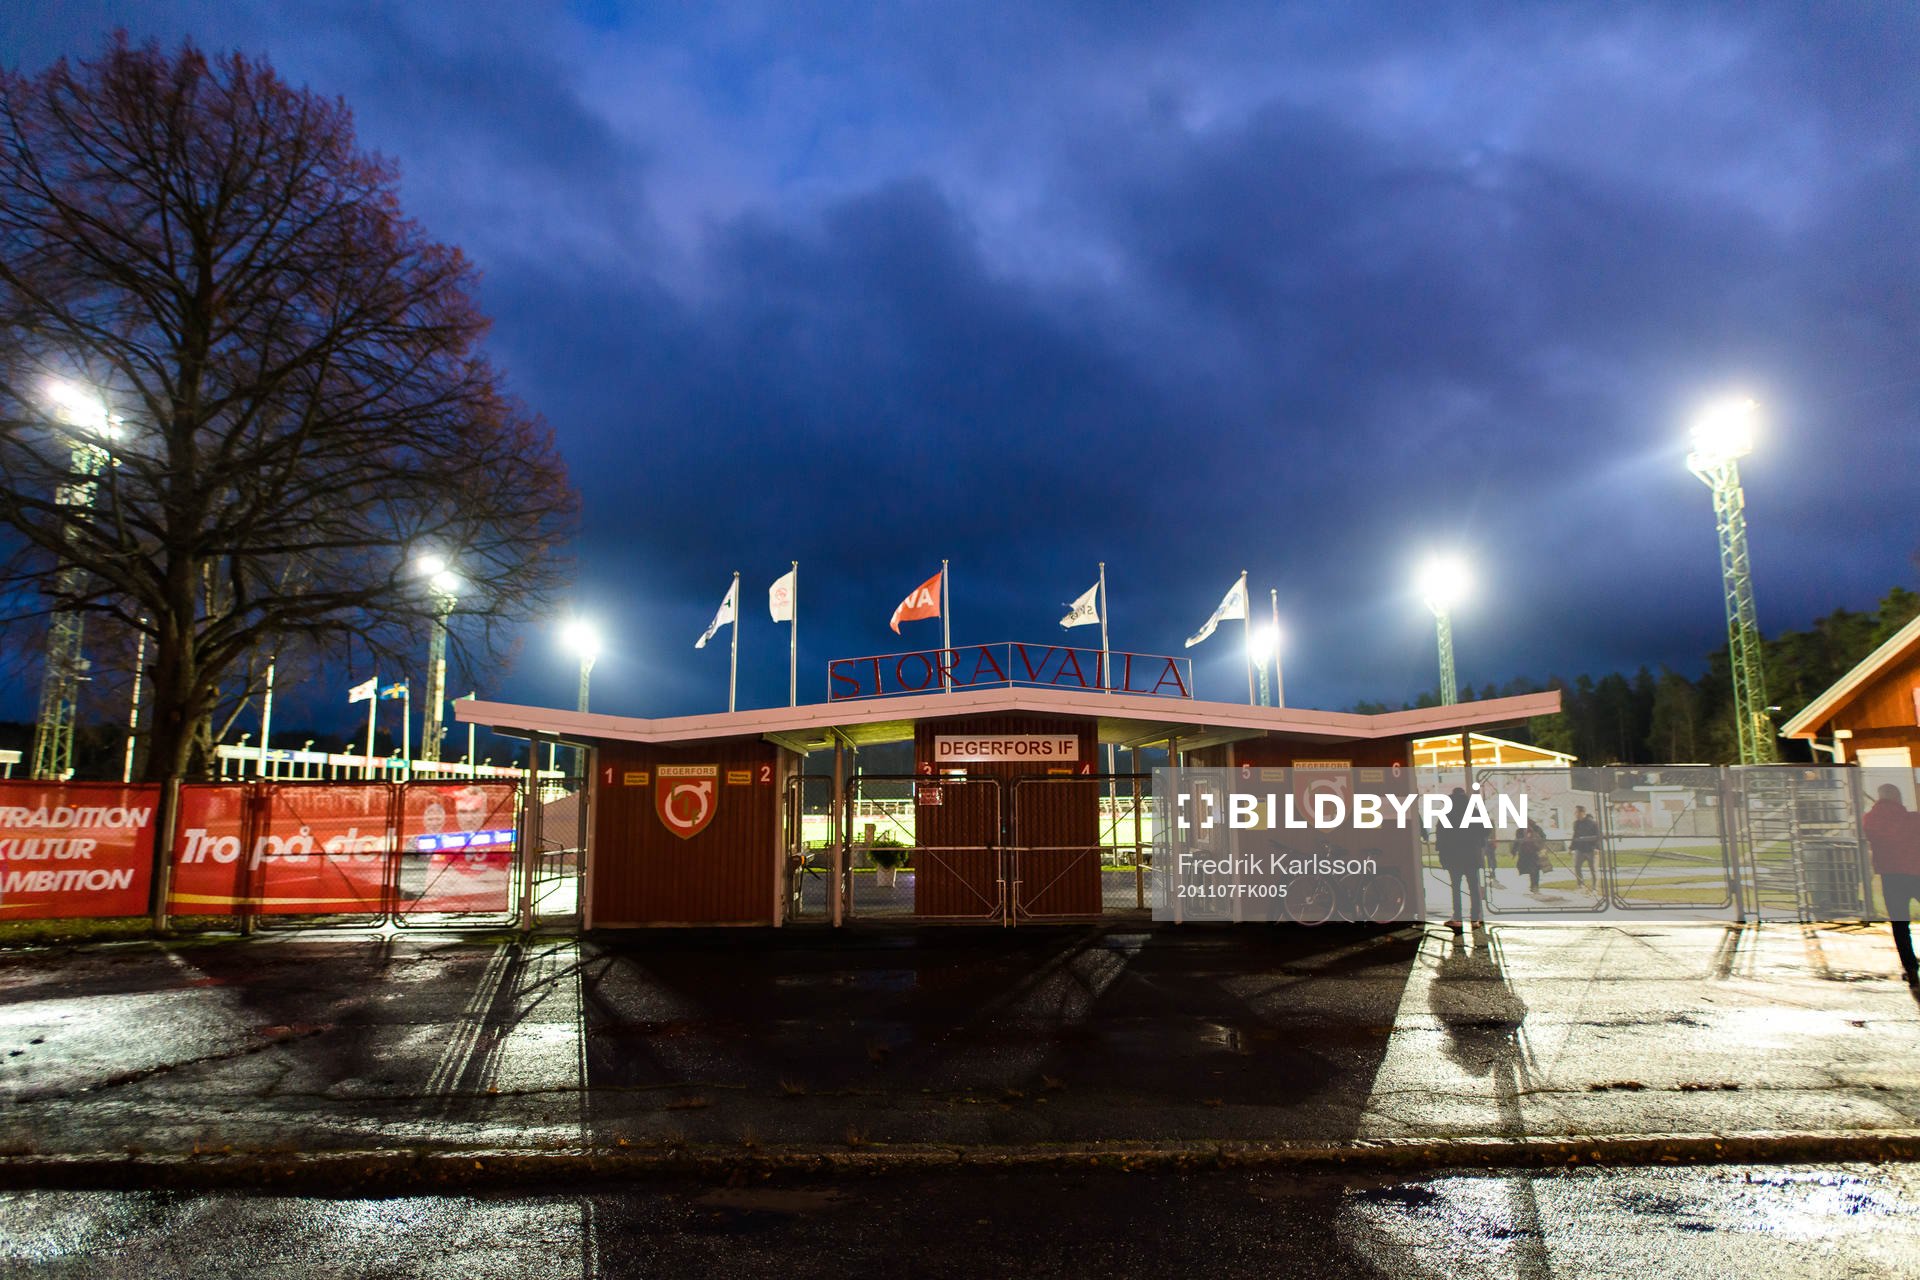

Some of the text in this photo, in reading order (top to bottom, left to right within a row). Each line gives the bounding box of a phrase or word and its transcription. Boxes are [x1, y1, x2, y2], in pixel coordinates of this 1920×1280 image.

[829, 644, 1192, 699] STORA VALLA
[940, 740, 1073, 755] DEGERFORS IF
[605, 767, 613, 784] 1
[661, 767, 714, 776] DEGERFORS
[761, 766, 771, 782] 2
[1242, 764, 1250, 779] 5
[1392, 763, 1400, 778] 6
[0, 806, 151, 828] TRADITION
[180, 828, 241, 864] Tro
[249, 826, 315, 871] på
